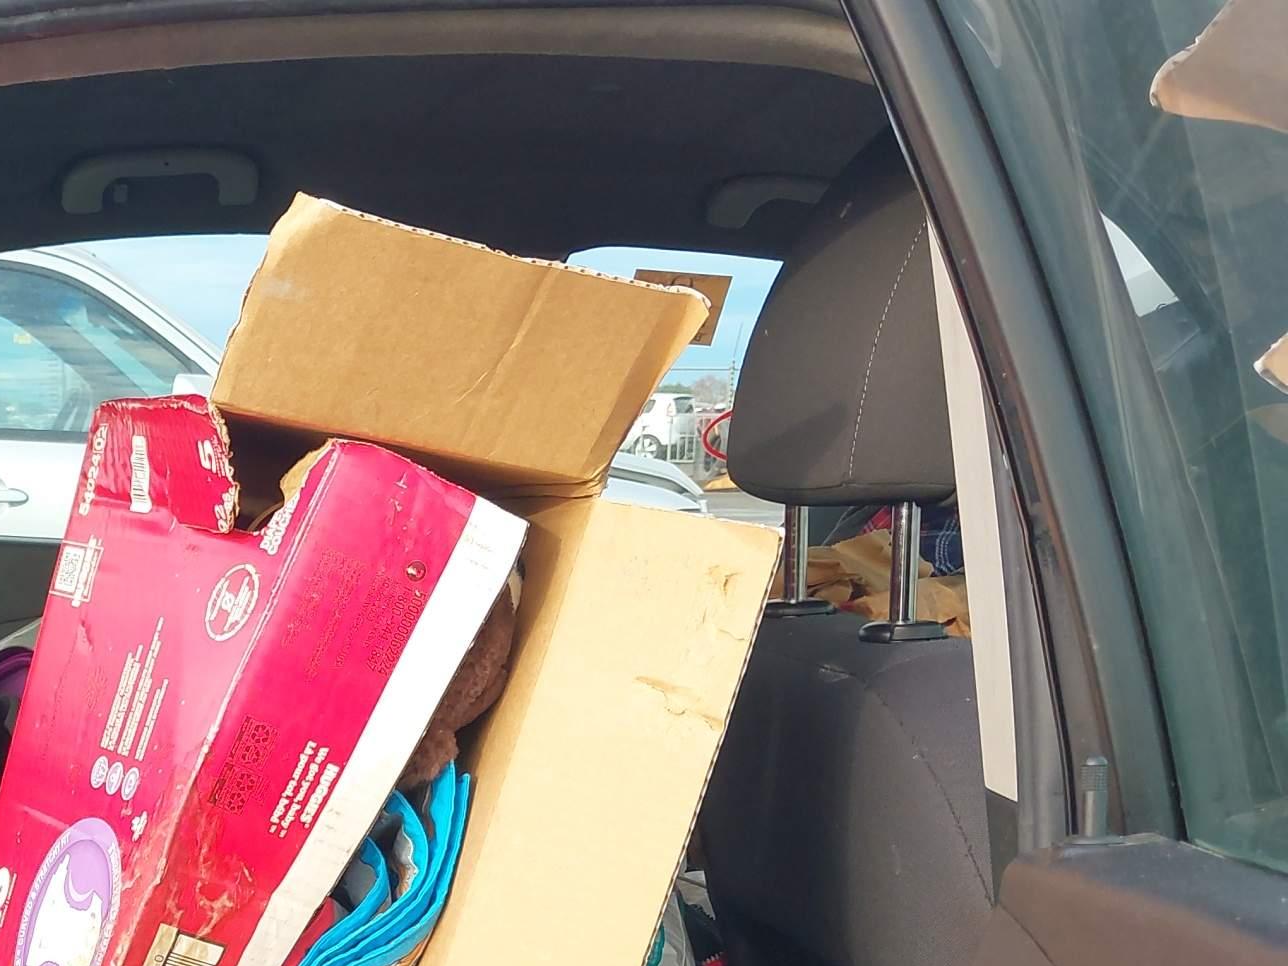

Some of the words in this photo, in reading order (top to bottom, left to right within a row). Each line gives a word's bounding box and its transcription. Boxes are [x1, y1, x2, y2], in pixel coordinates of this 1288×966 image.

[78, 454, 100, 516] 54024
[93, 425, 109, 452] 02
[300, 762, 341, 824] HUGGIES
